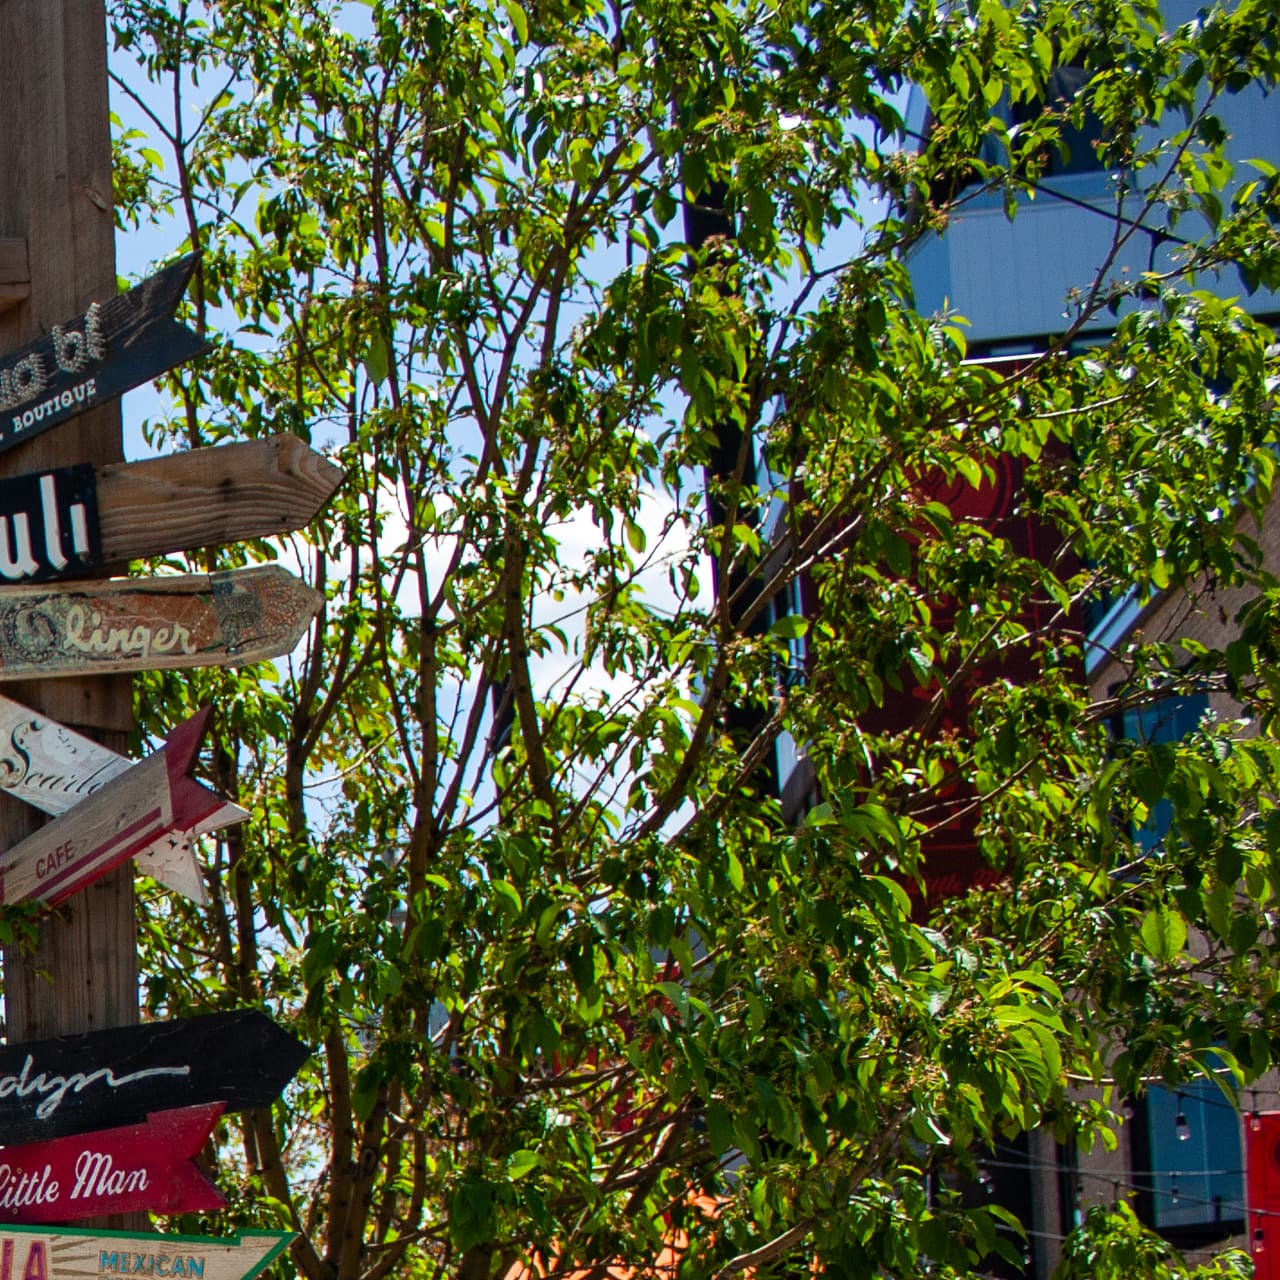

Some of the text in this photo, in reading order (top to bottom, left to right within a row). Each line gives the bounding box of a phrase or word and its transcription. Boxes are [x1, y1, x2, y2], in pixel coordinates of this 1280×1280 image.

[12, 378, 97, 432] BOUTIQUE
[35, 839, 75, 880] CAFE
[70, 1150, 149, 1200] Man
[98, 1250, 206, 1280] MEXICAN
